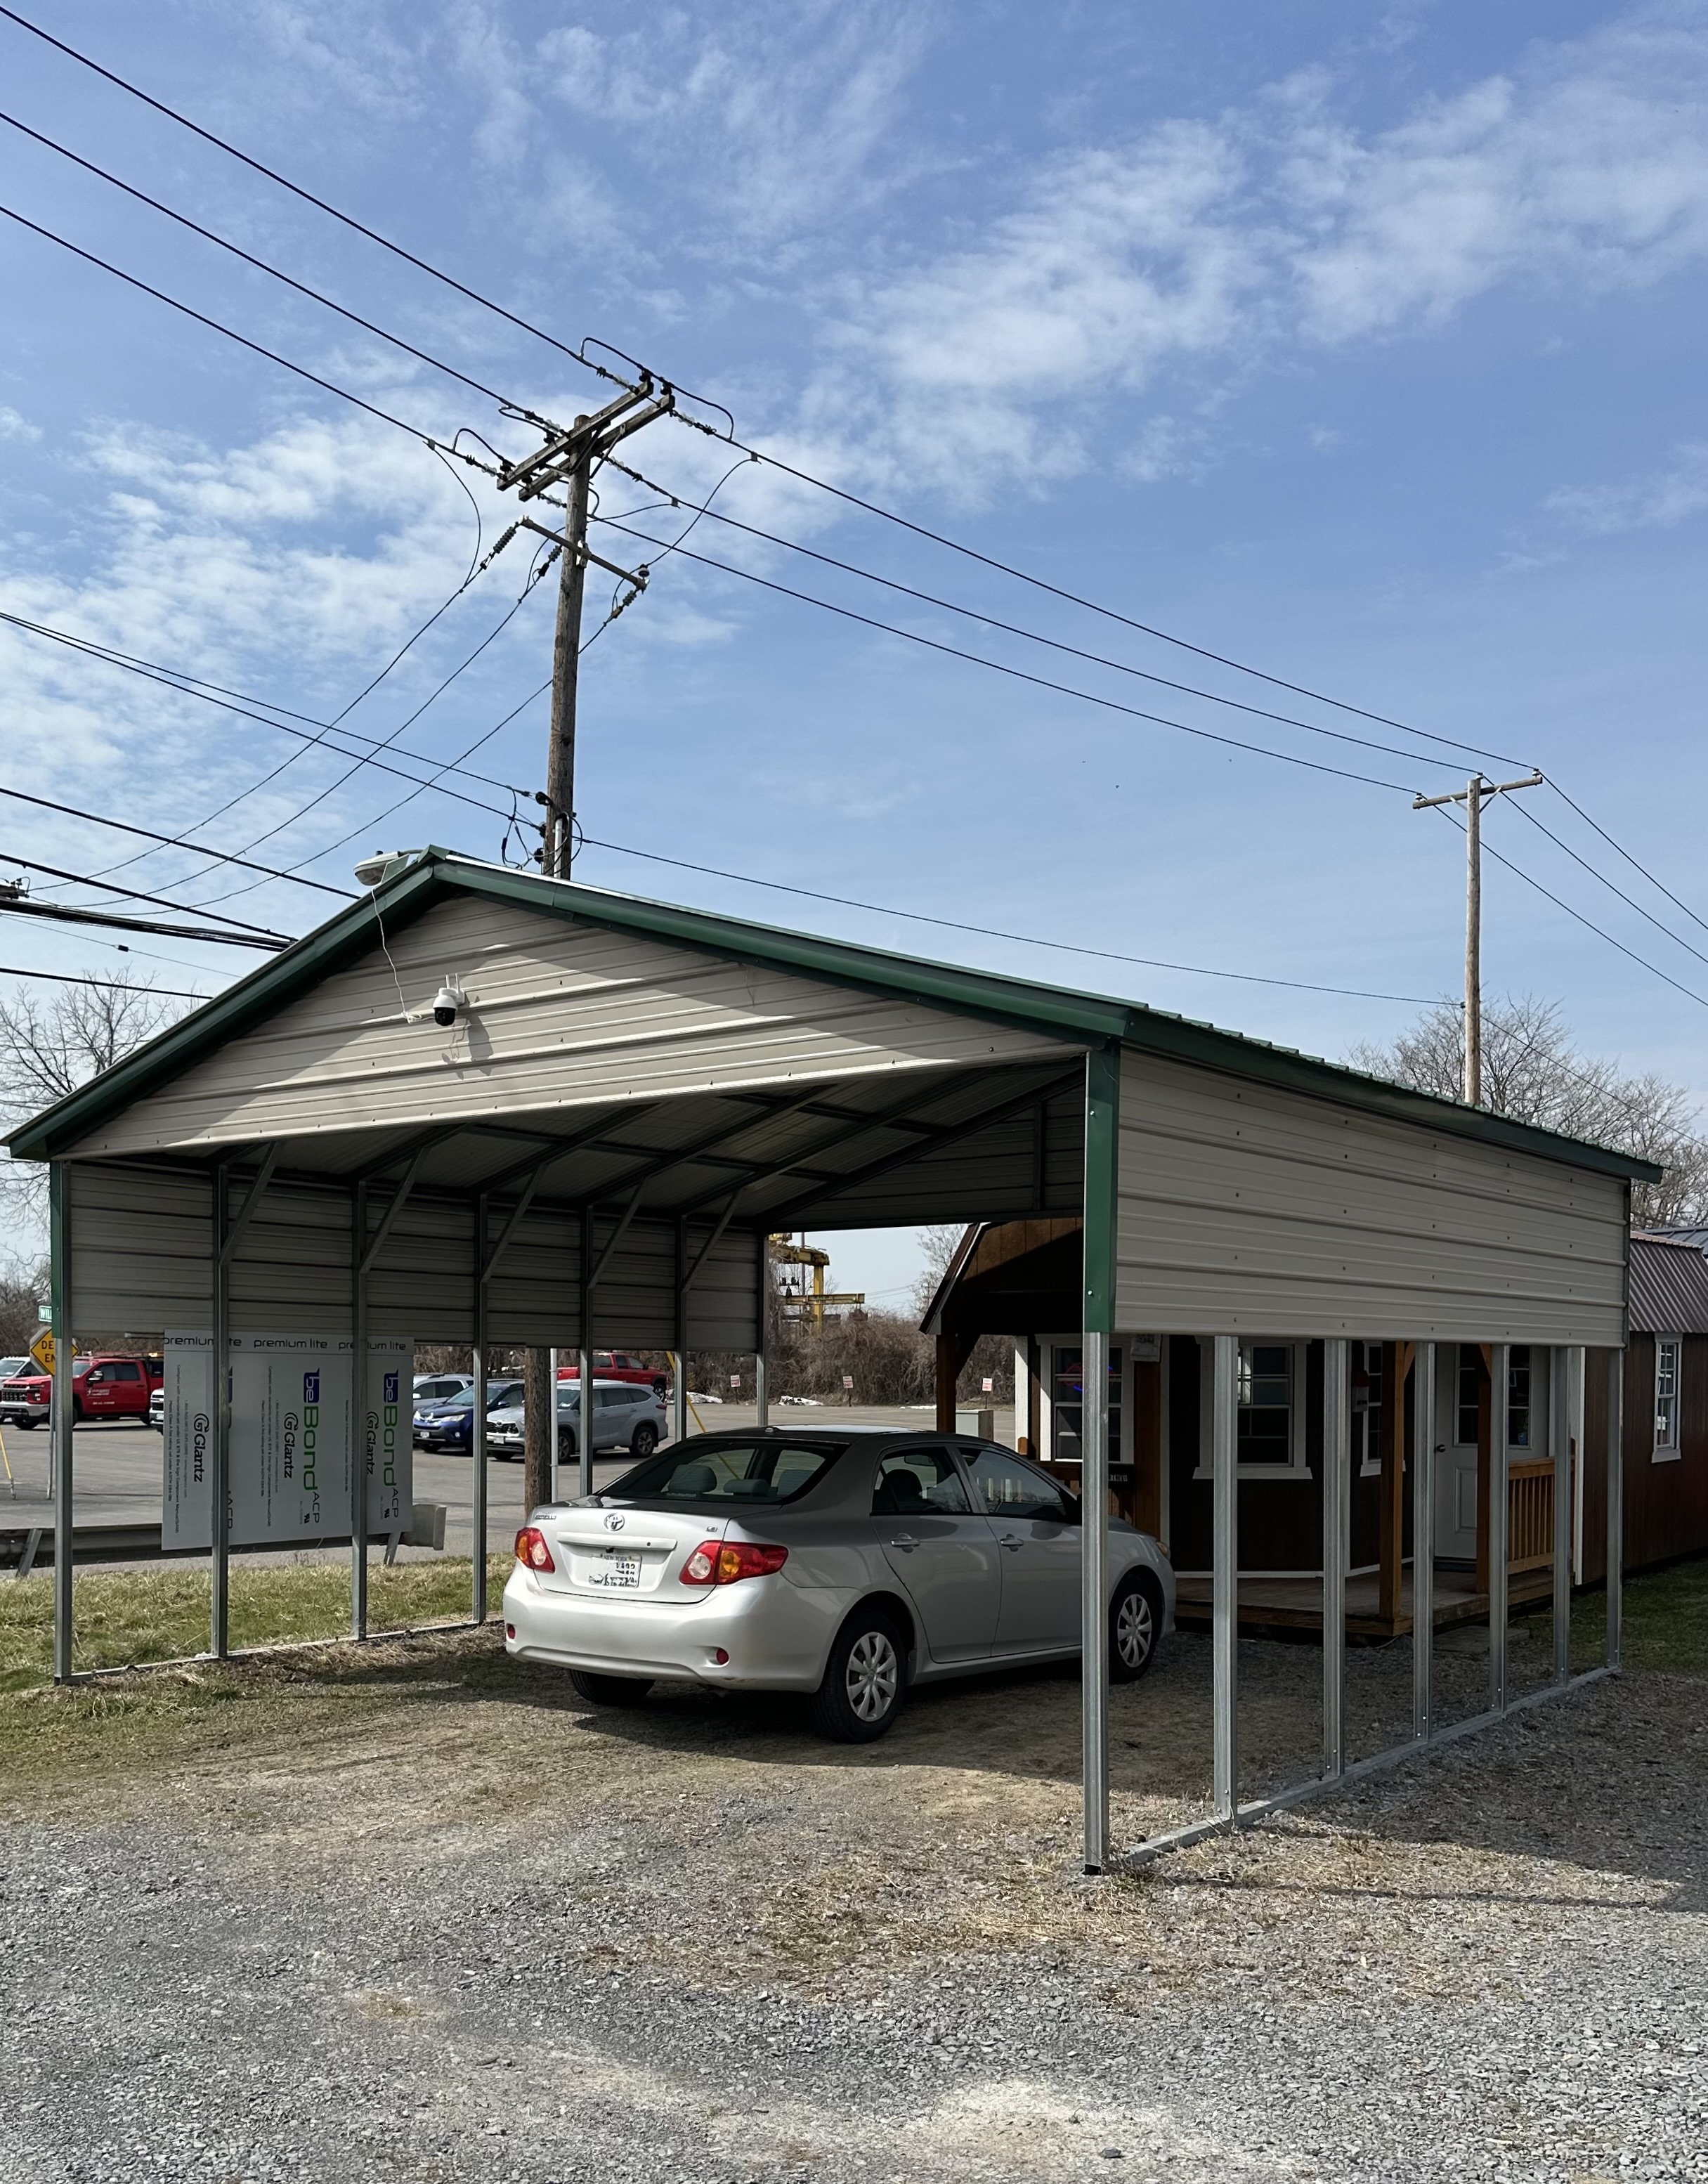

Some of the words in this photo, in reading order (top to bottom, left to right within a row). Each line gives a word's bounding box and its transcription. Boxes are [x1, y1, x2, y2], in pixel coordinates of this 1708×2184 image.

[41, 1340, 54, 1350] DE
[254, 1339, 307, 1348] premium
[310, 1339, 327, 1348] lite
[390, 1341, 406, 1351] lite
[194, 1434, 206, 1482] Glantz
[284, 1432, 295, 1478] Glantz
[367, 1431, 377, 1474] Glantz
